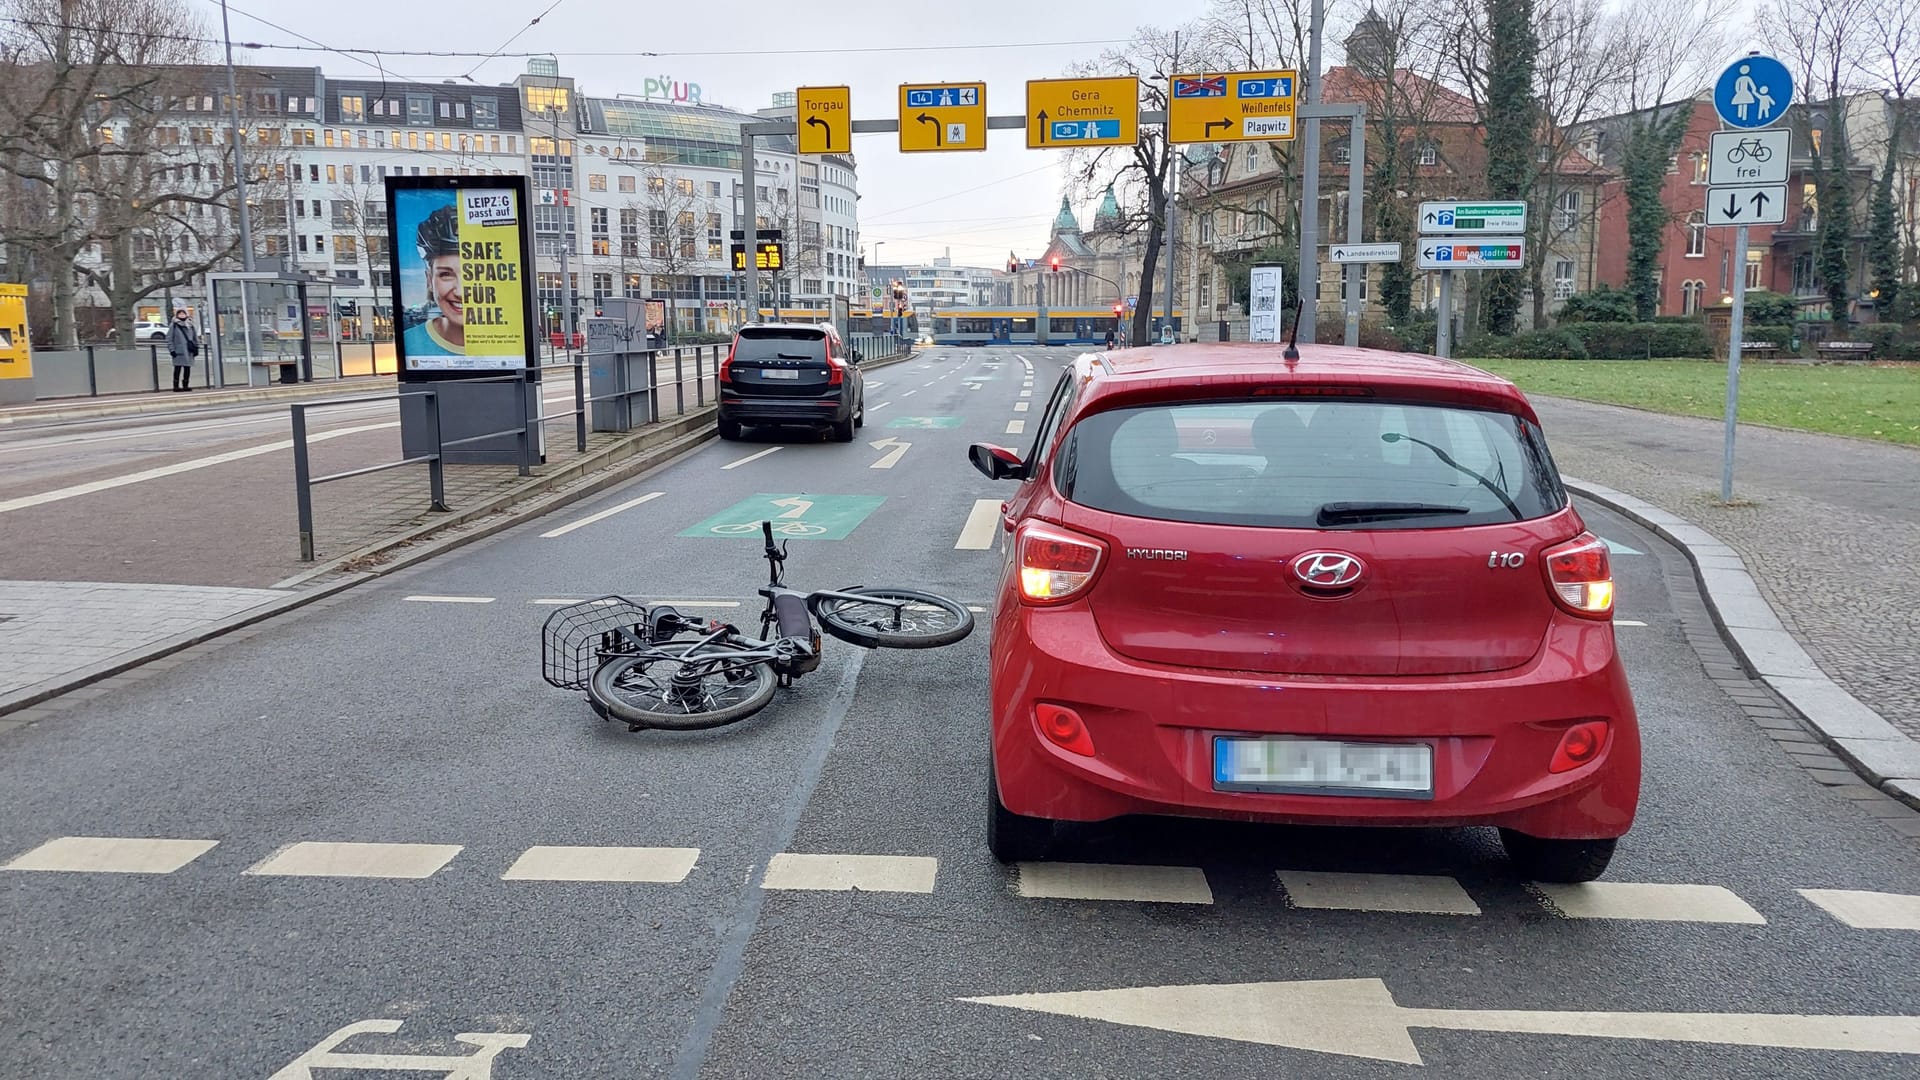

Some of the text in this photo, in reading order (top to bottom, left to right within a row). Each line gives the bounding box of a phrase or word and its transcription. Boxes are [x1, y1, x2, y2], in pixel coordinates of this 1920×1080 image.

[1072, 89, 1100, 101] Gera
[1250, 84, 1256, 93] 9
[917, 93, 927, 103] 14
[805, 99, 844, 113] Torgau
[1057, 104, 1114, 117] Chemnitz
[1241, 101, 1291, 113] Weißenfels
[1062, 126, 1072, 135] 38
[1247, 121, 1287, 135] Plagwitz
[1736, 165, 1761, 177] frei
[469, 207, 511, 220] passt auf
[461, 241, 503, 260] SAFE
[1346, 249, 1398, 257] Landesdirektion
[462, 262, 517, 281] SPACE
[463, 282, 497, 304] FÜR
[465, 306, 509, 325] ALLE.
[1127, 548, 1188, 561] HYUNDAI
[1488, 550, 1525, 569] i10
